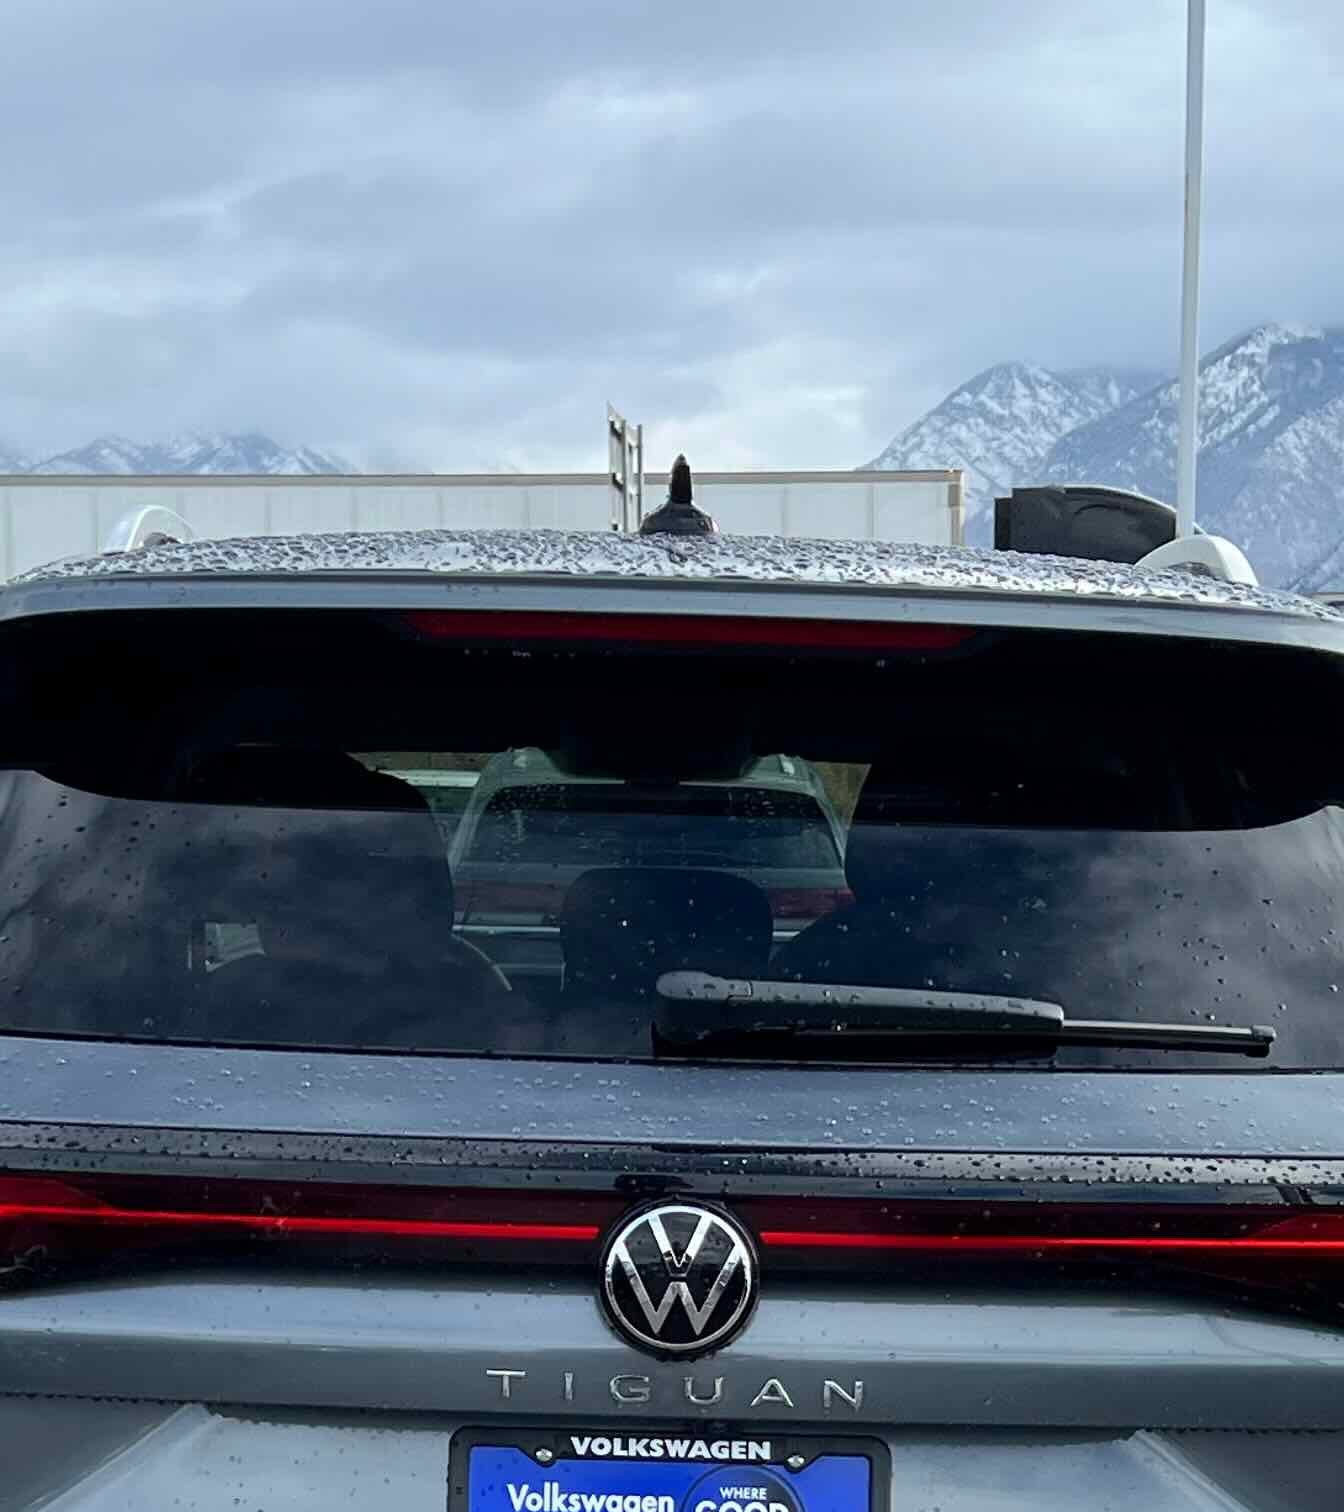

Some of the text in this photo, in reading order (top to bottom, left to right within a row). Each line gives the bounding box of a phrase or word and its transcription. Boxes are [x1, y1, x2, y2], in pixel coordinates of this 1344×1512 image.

[606, 1206, 752, 1351] VW
[486, 1369, 864, 1409] TIGUAN
[570, 1436, 772, 1461] VOLKSWAGEN
[719, 1486, 768, 1500] WHERE
